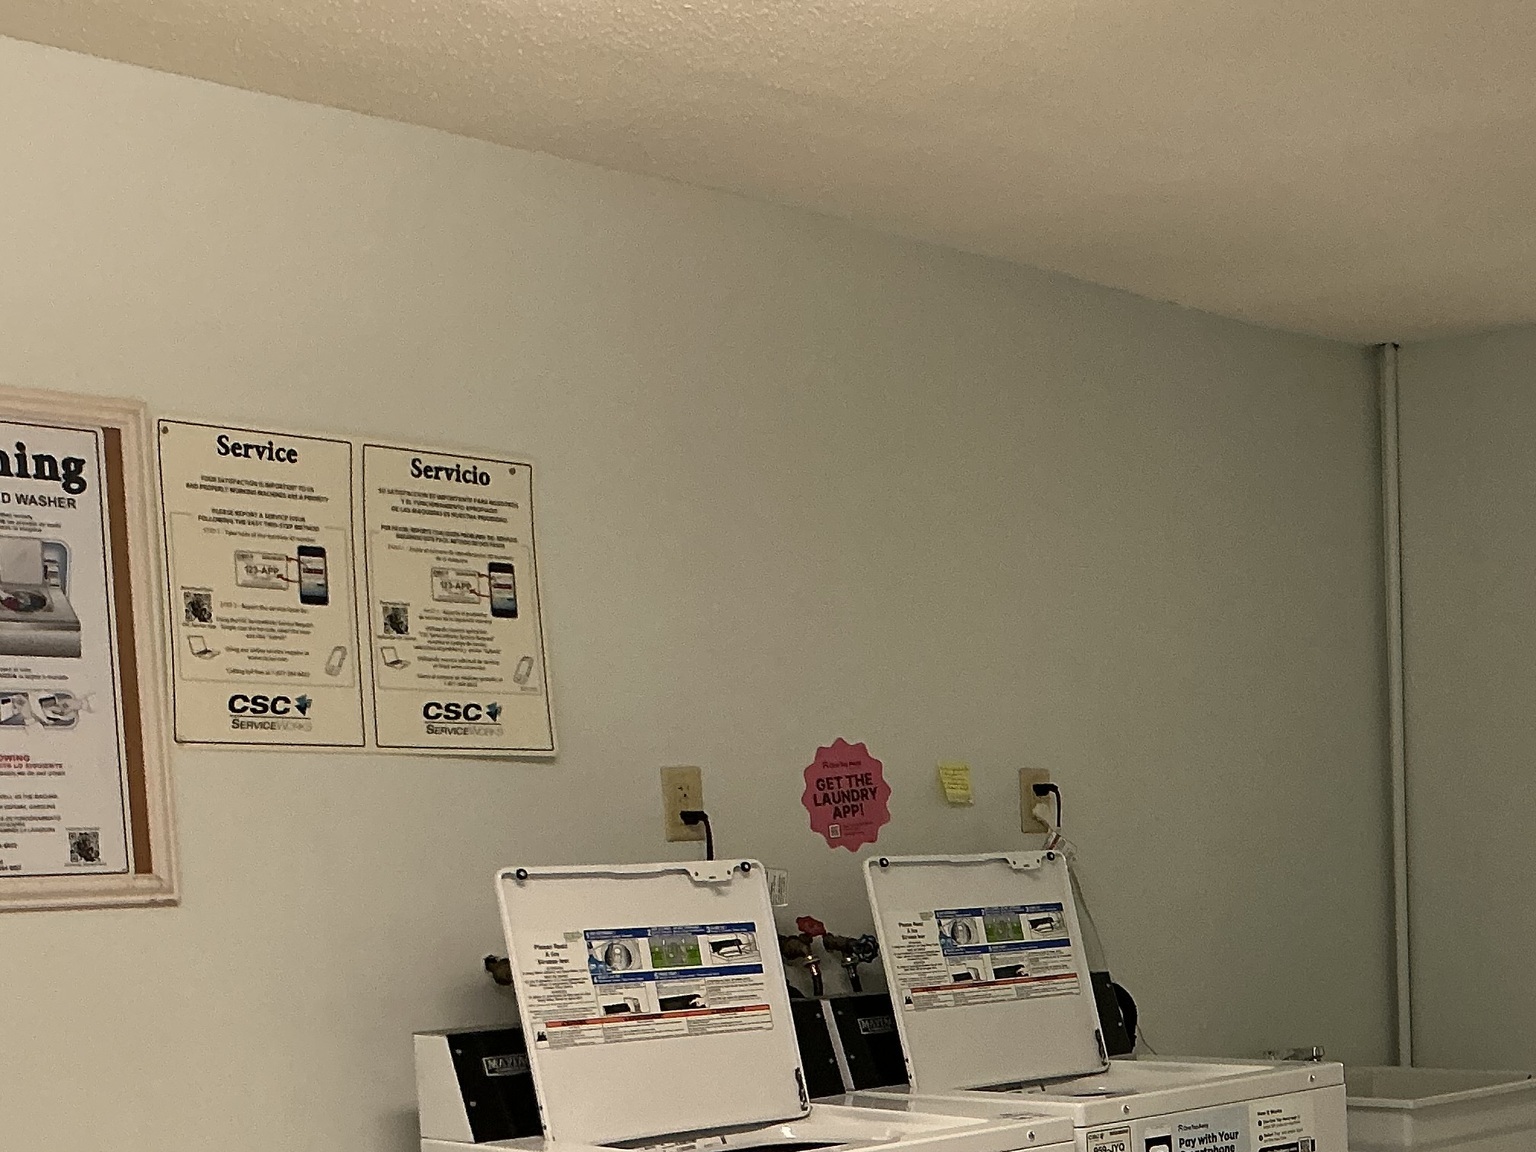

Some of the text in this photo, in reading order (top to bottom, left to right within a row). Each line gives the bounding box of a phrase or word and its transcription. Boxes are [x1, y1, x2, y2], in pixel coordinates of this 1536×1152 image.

[217, 435, 298, 463] Service
[410, 458, 491, 487] Servicio
[15, 493, 76, 510] WASHER
[228, 694, 291, 715] CSC
[423, 702, 482, 721] CSC
[816, 772, 873, 791] GET THE
[813, 786, 878, 807] LAUNDRY
[832, 802, 865, 820] APP!
[1179, 1131, 1239, 1148] Pay with Your
